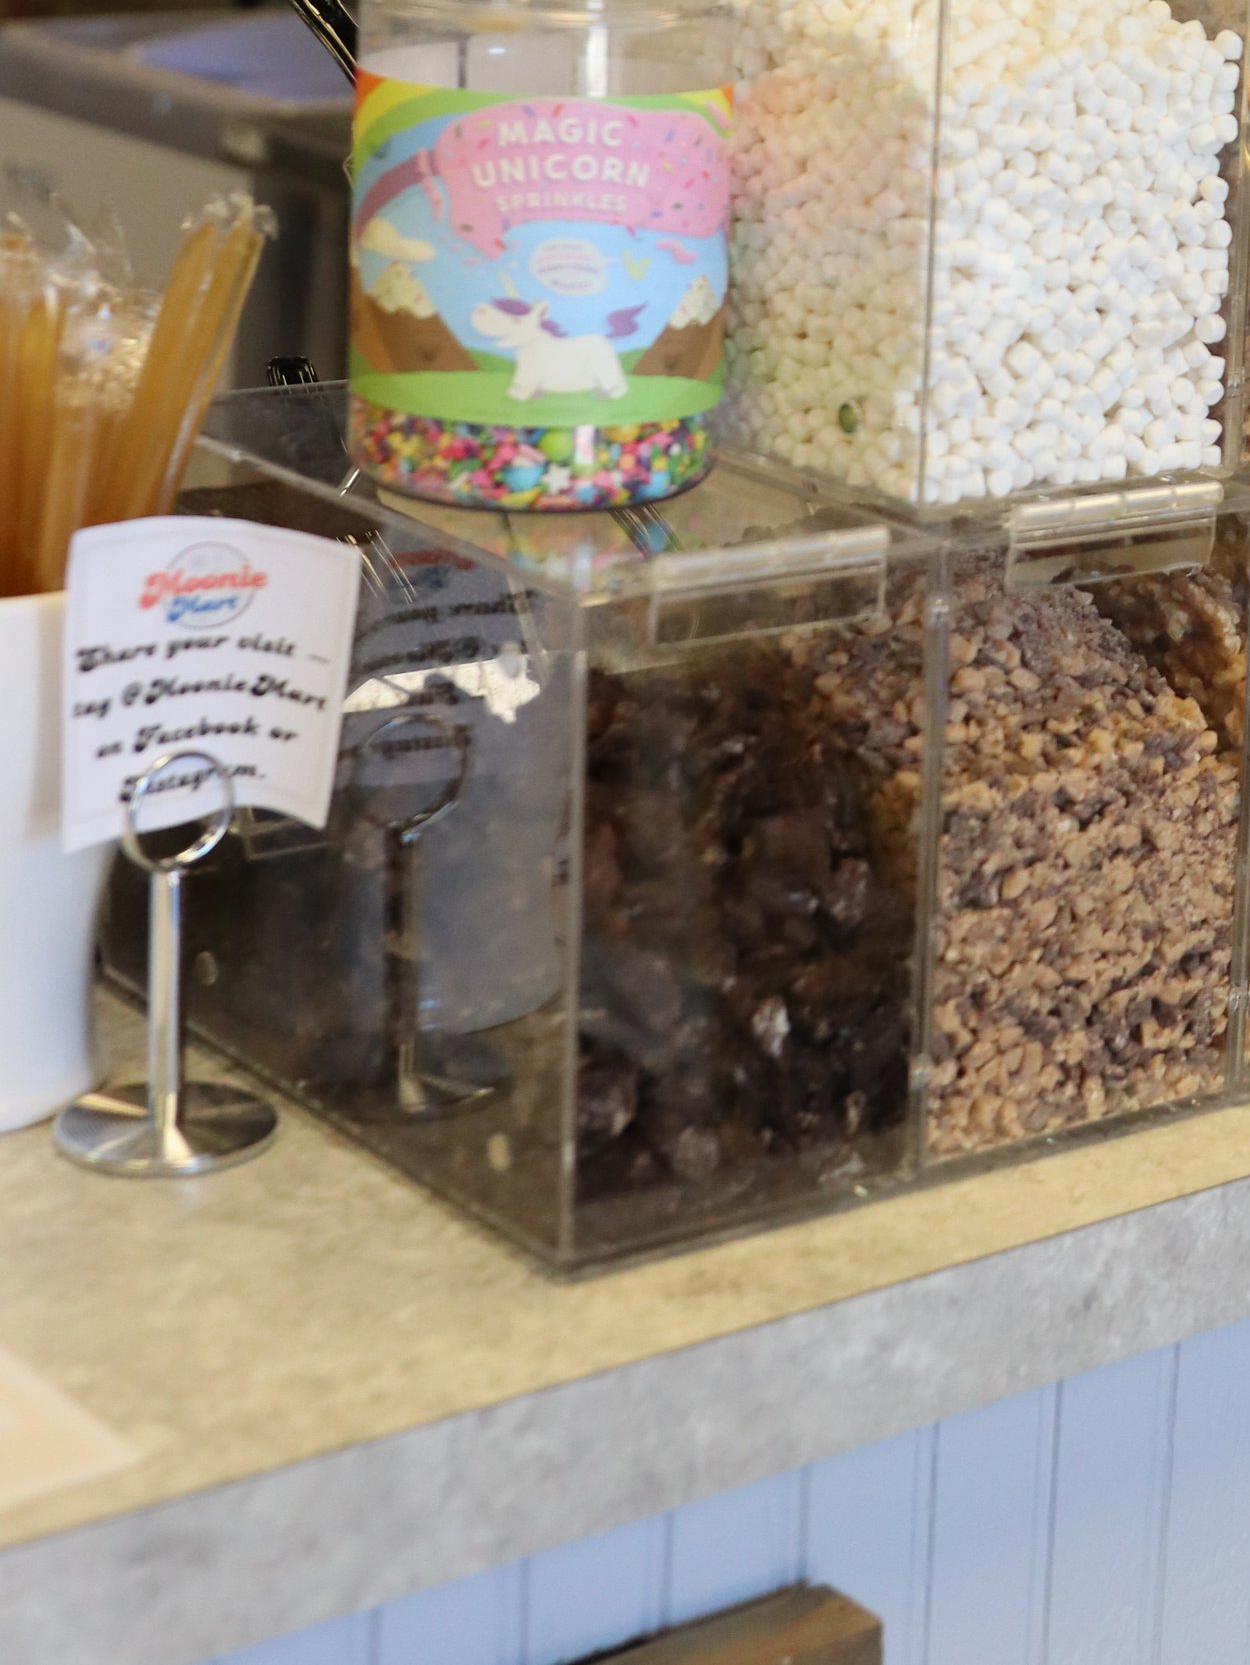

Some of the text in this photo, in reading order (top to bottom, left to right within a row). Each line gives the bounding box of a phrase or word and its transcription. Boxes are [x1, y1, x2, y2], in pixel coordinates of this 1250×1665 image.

[498, 116, 625, 148] MAGIC
[471, 153, 650, 189] UNICORN
[496, 192, 626, 213] SPRINKLES
[138, 564, 269, 610] Moonie
[166, 594, 238, 623] Mart
[165, 636, 229, 662] your
[236, 634, 295, 657] visit
[73, 698, 112, 719] tag
[95, 715, 300, 760] on Facebook or
